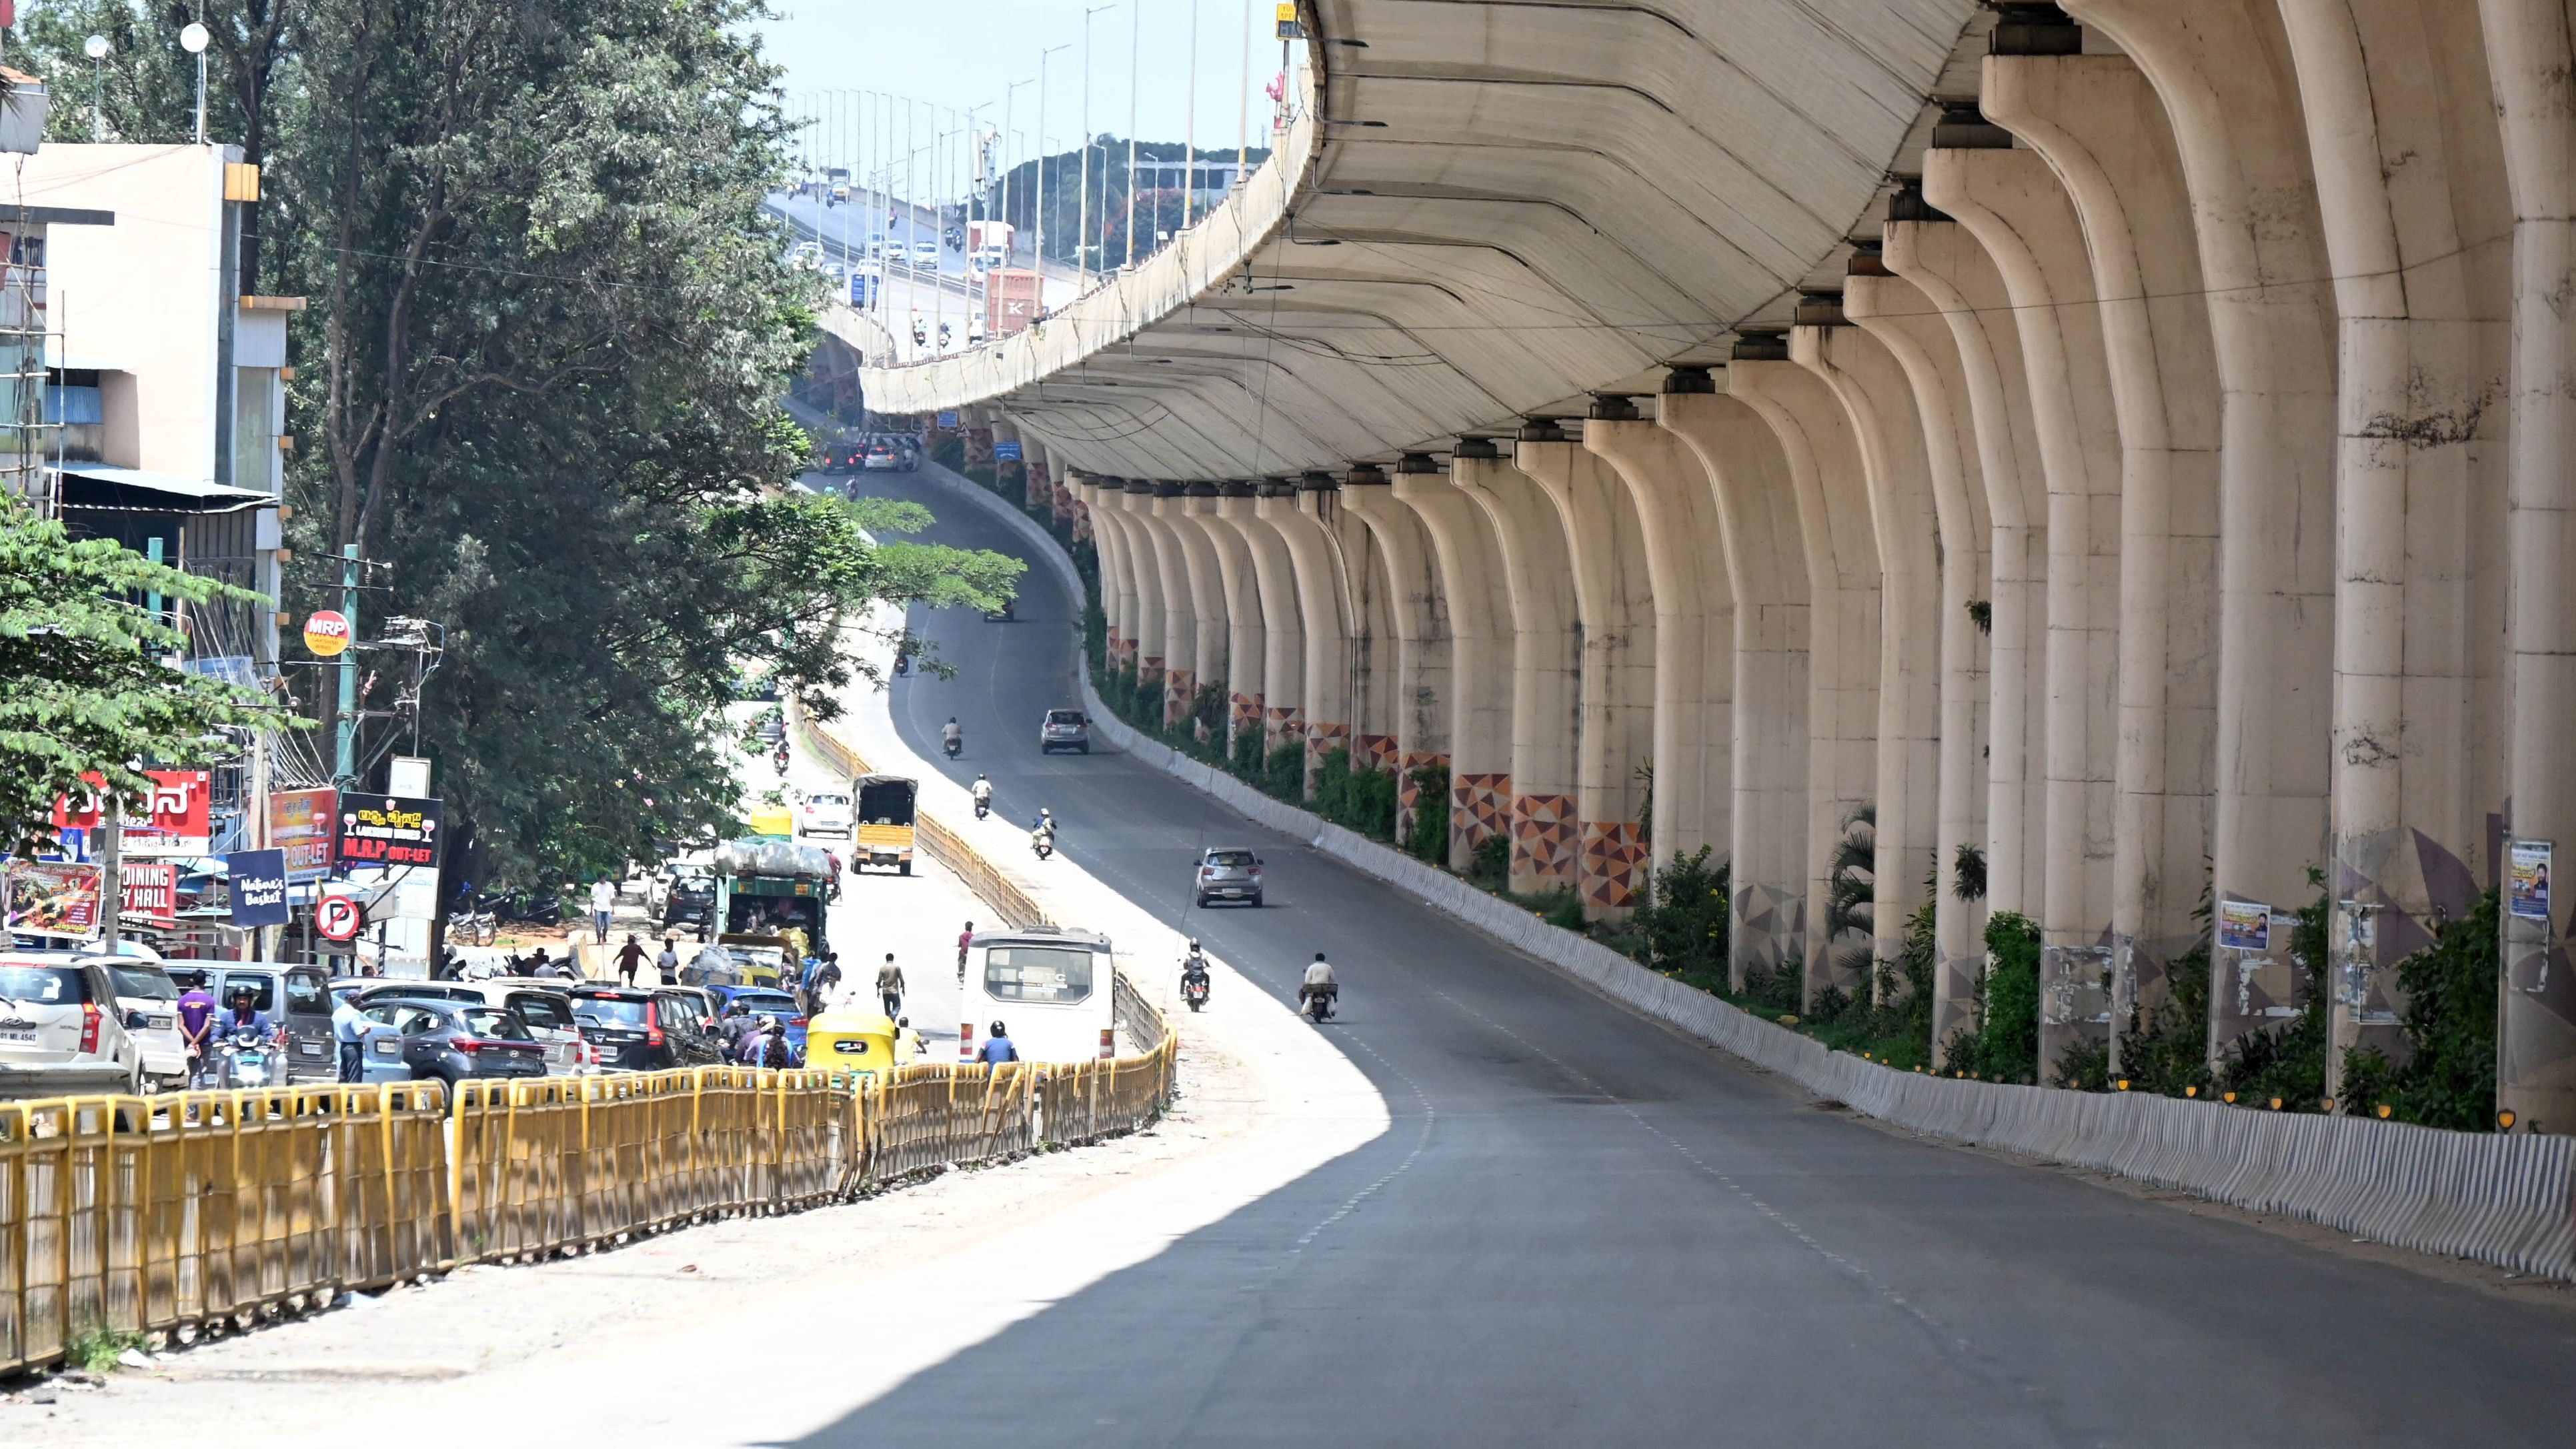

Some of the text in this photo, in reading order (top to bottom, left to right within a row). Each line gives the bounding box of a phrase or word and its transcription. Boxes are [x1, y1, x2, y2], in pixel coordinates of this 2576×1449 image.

[309, 618, 345, 635] MRP
[291, 842, 329, 868] OUT-LET
[343, 838, 432, 862] M.R.P OUT-LET
[123, 867, 169, 886] DINING
[241, 878, 283, 892] Nature's
[134, 888, 167, 908] HALL
[245, 890, 281, 906] Basket
